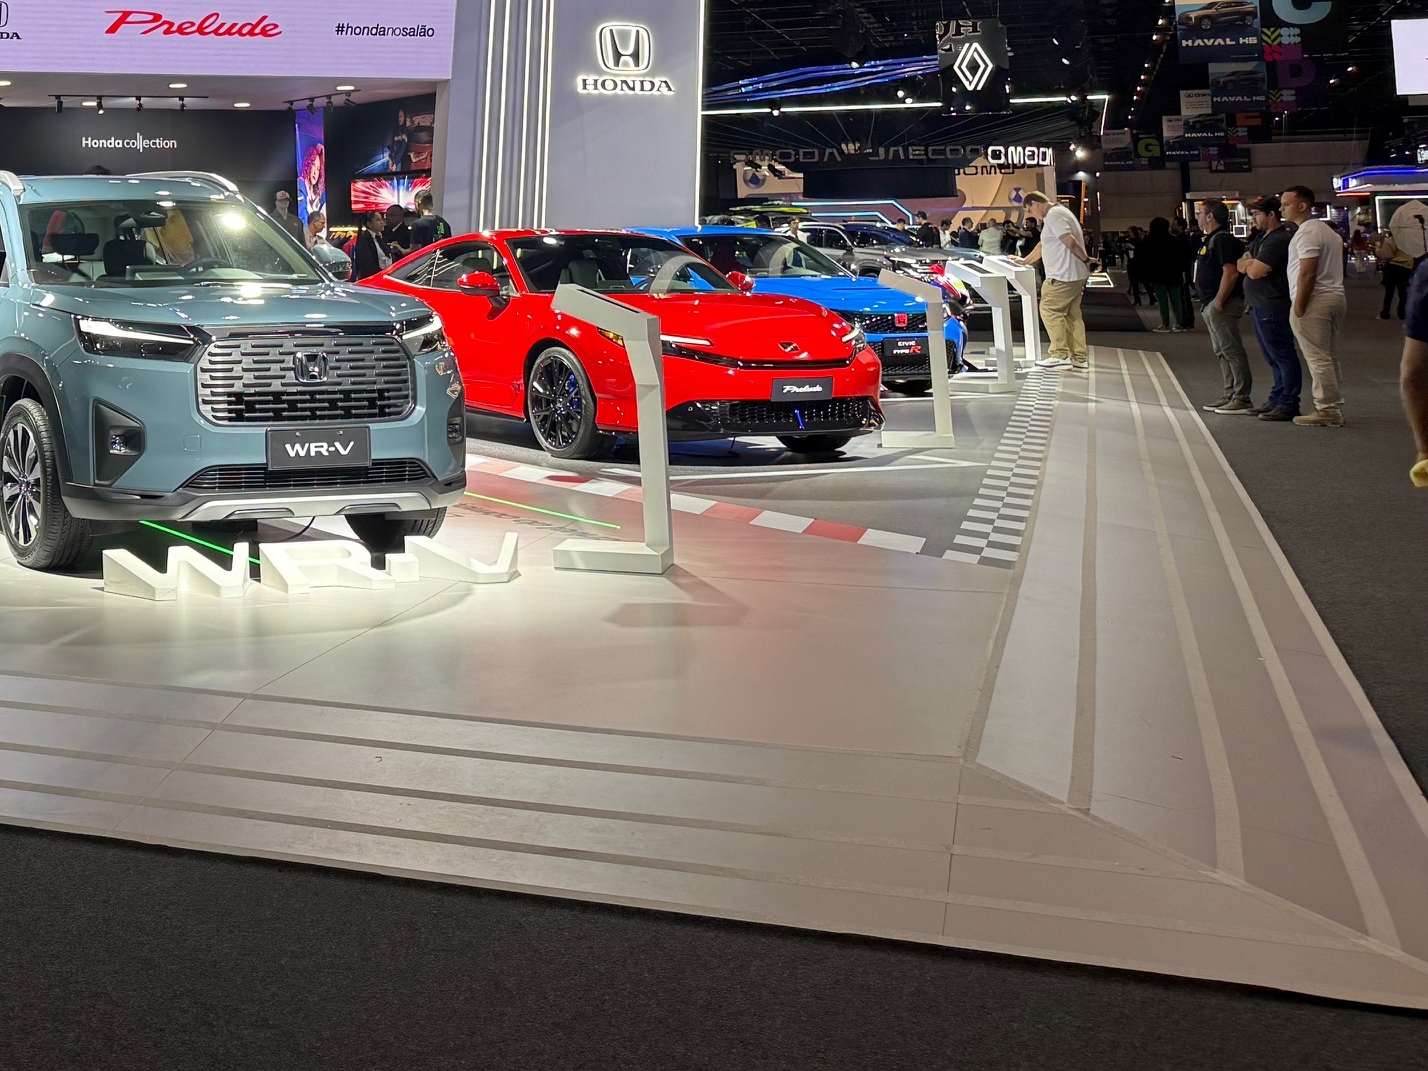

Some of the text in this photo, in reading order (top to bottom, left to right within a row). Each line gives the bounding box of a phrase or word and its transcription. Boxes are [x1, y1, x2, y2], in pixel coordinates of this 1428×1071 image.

[104, 9, 283, 39] Prelude
[335, 23, 436, 38] #hondanosalão
[1181, 36, 1258, 47] HAVAL H6
[581, 78, 676, 93] HONDA
[730, 148, 842, 163] OMODA
[1137, 138, 1162, 158] G
[782, 384, 823, 394] Prelude
[284, 440, 355, 458] WR-V
